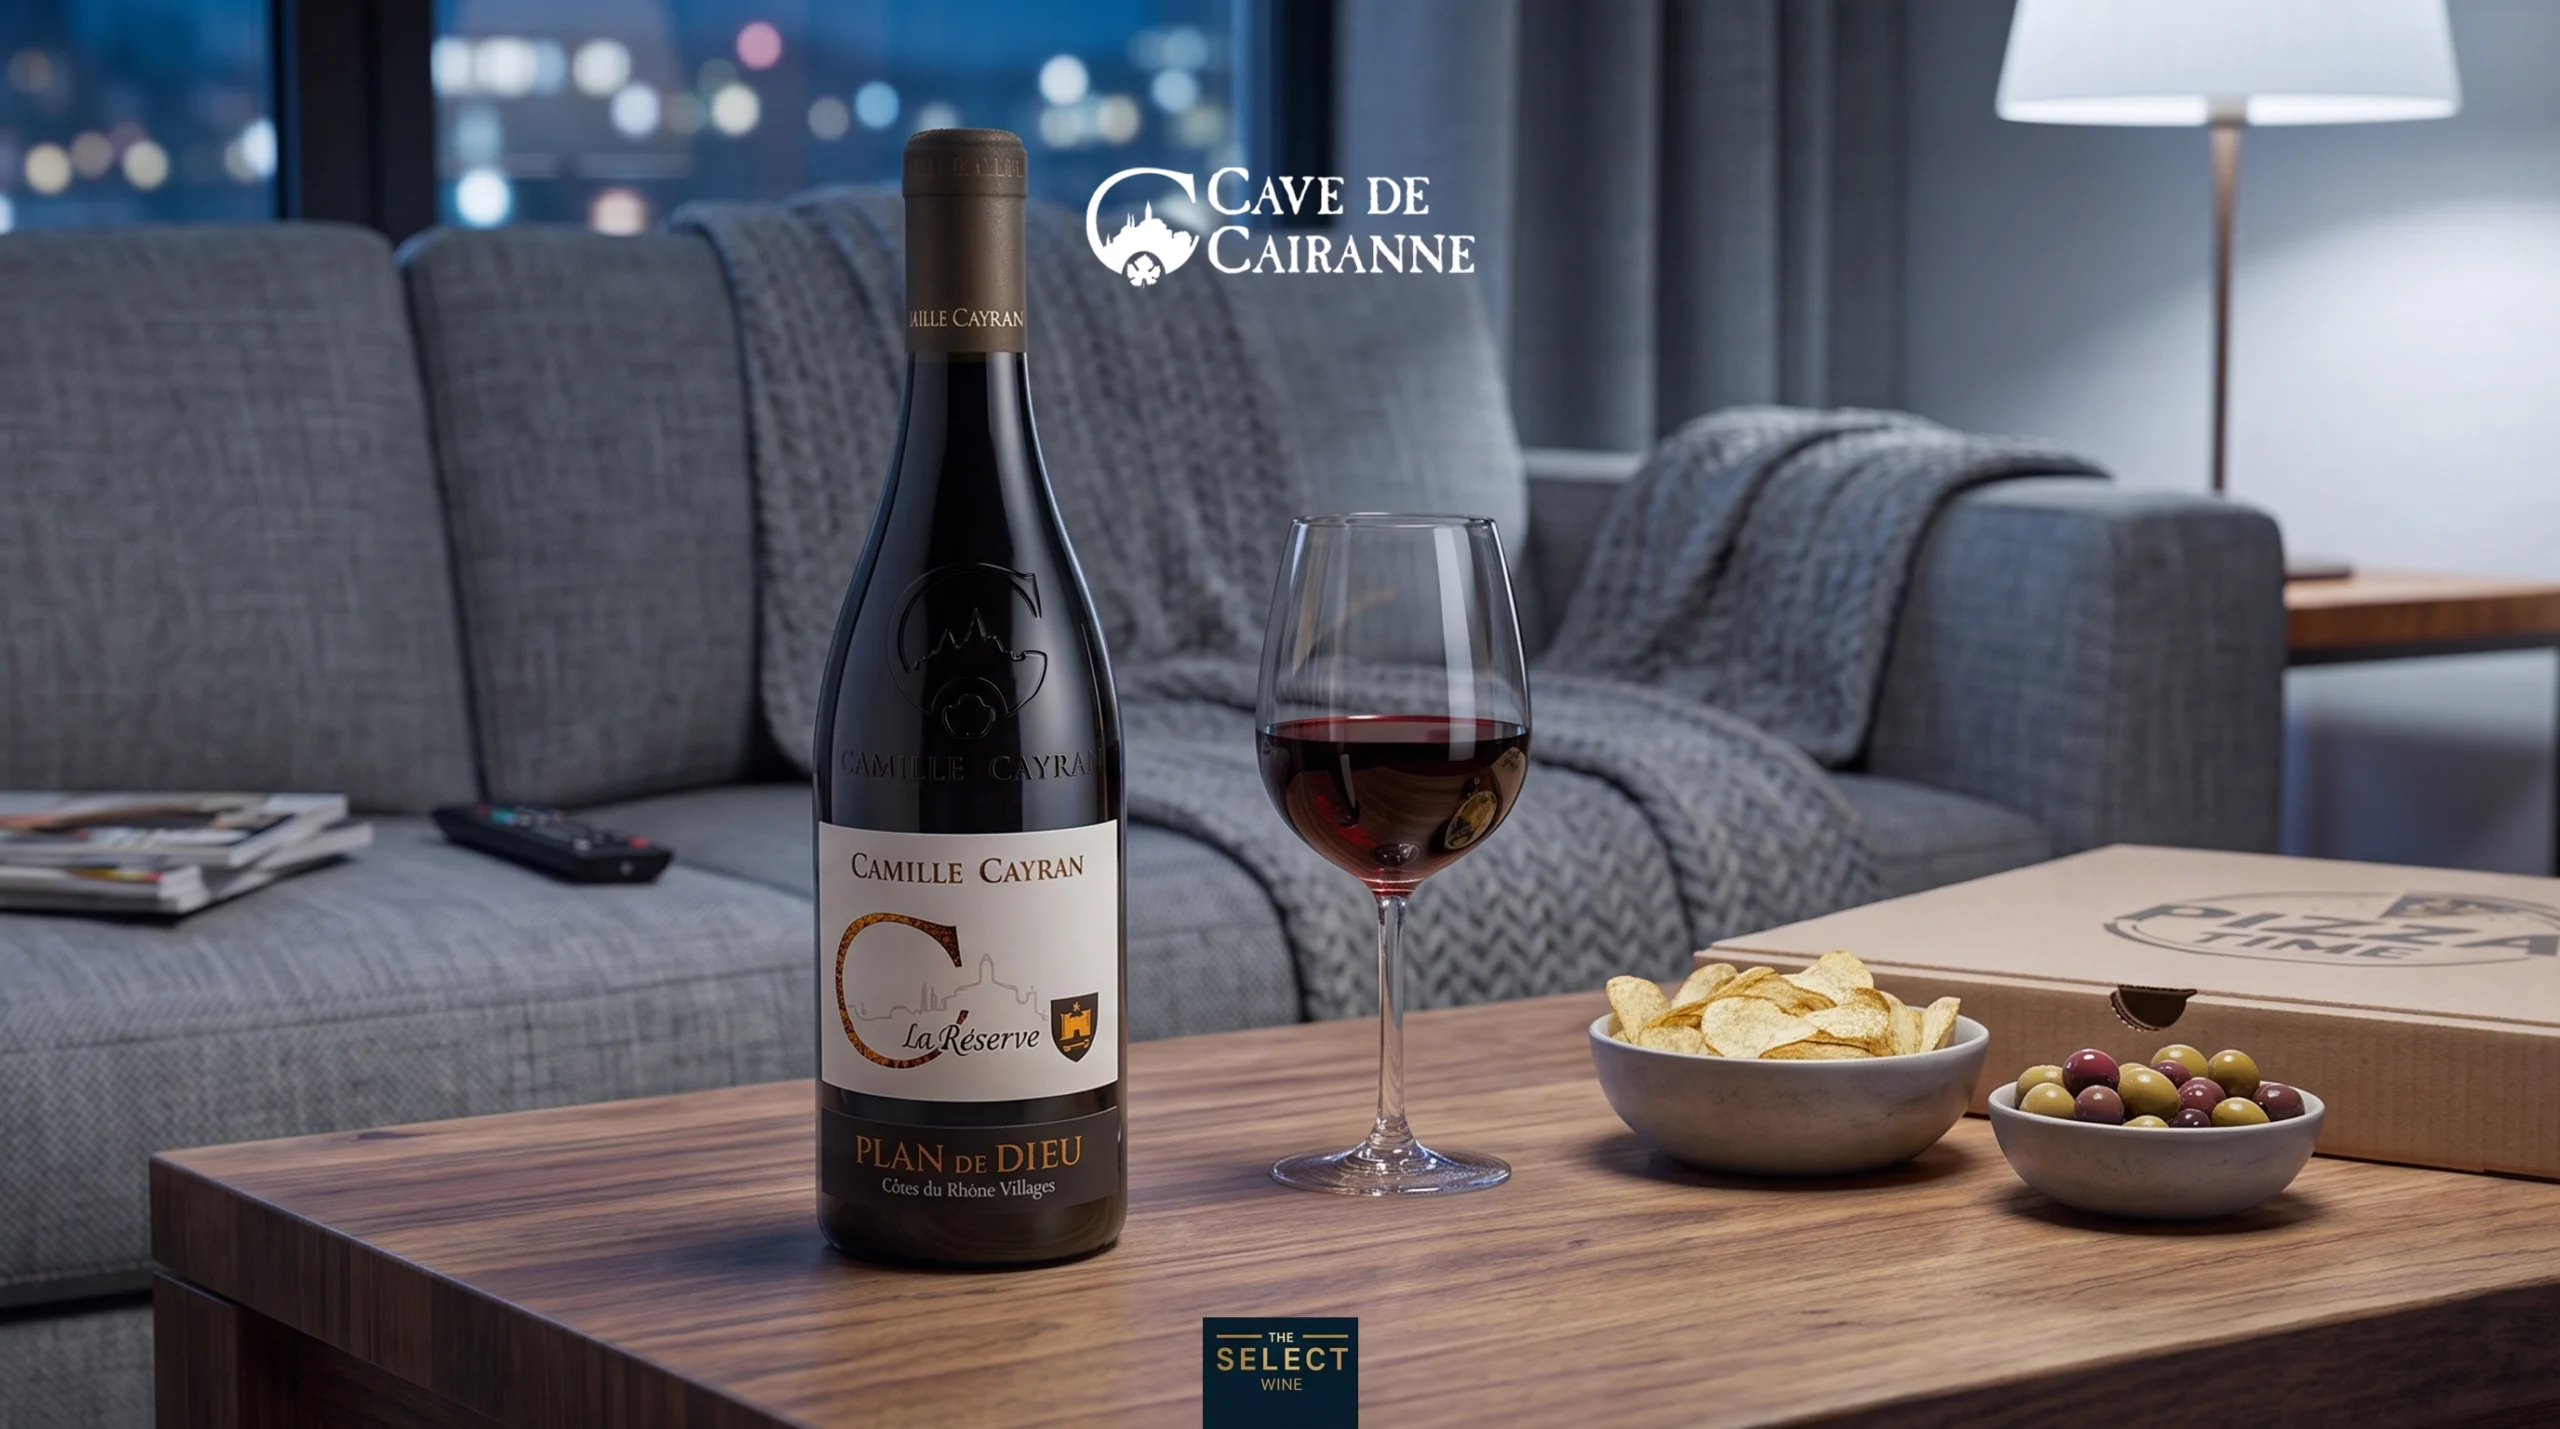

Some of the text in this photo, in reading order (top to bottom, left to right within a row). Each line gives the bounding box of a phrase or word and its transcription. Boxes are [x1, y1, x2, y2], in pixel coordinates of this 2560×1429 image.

[952, 308, 1024, 328] CAYRAN
[841, 750, 964, 781] CAMILLE
[851, 852, 1084, 884] CAMILLE CAYRAN
[2114, 903, 2559, 956] PIZZA
[2193, 931, 2424, 960] TIME
[902, 1020, 1040, 1057] La Réserve
[855, 1135, 1082, 1174] PLAN DE DIEU
[923, 1180, 942, 1197] du
[999, 1178, 1056, 1199] Villages
